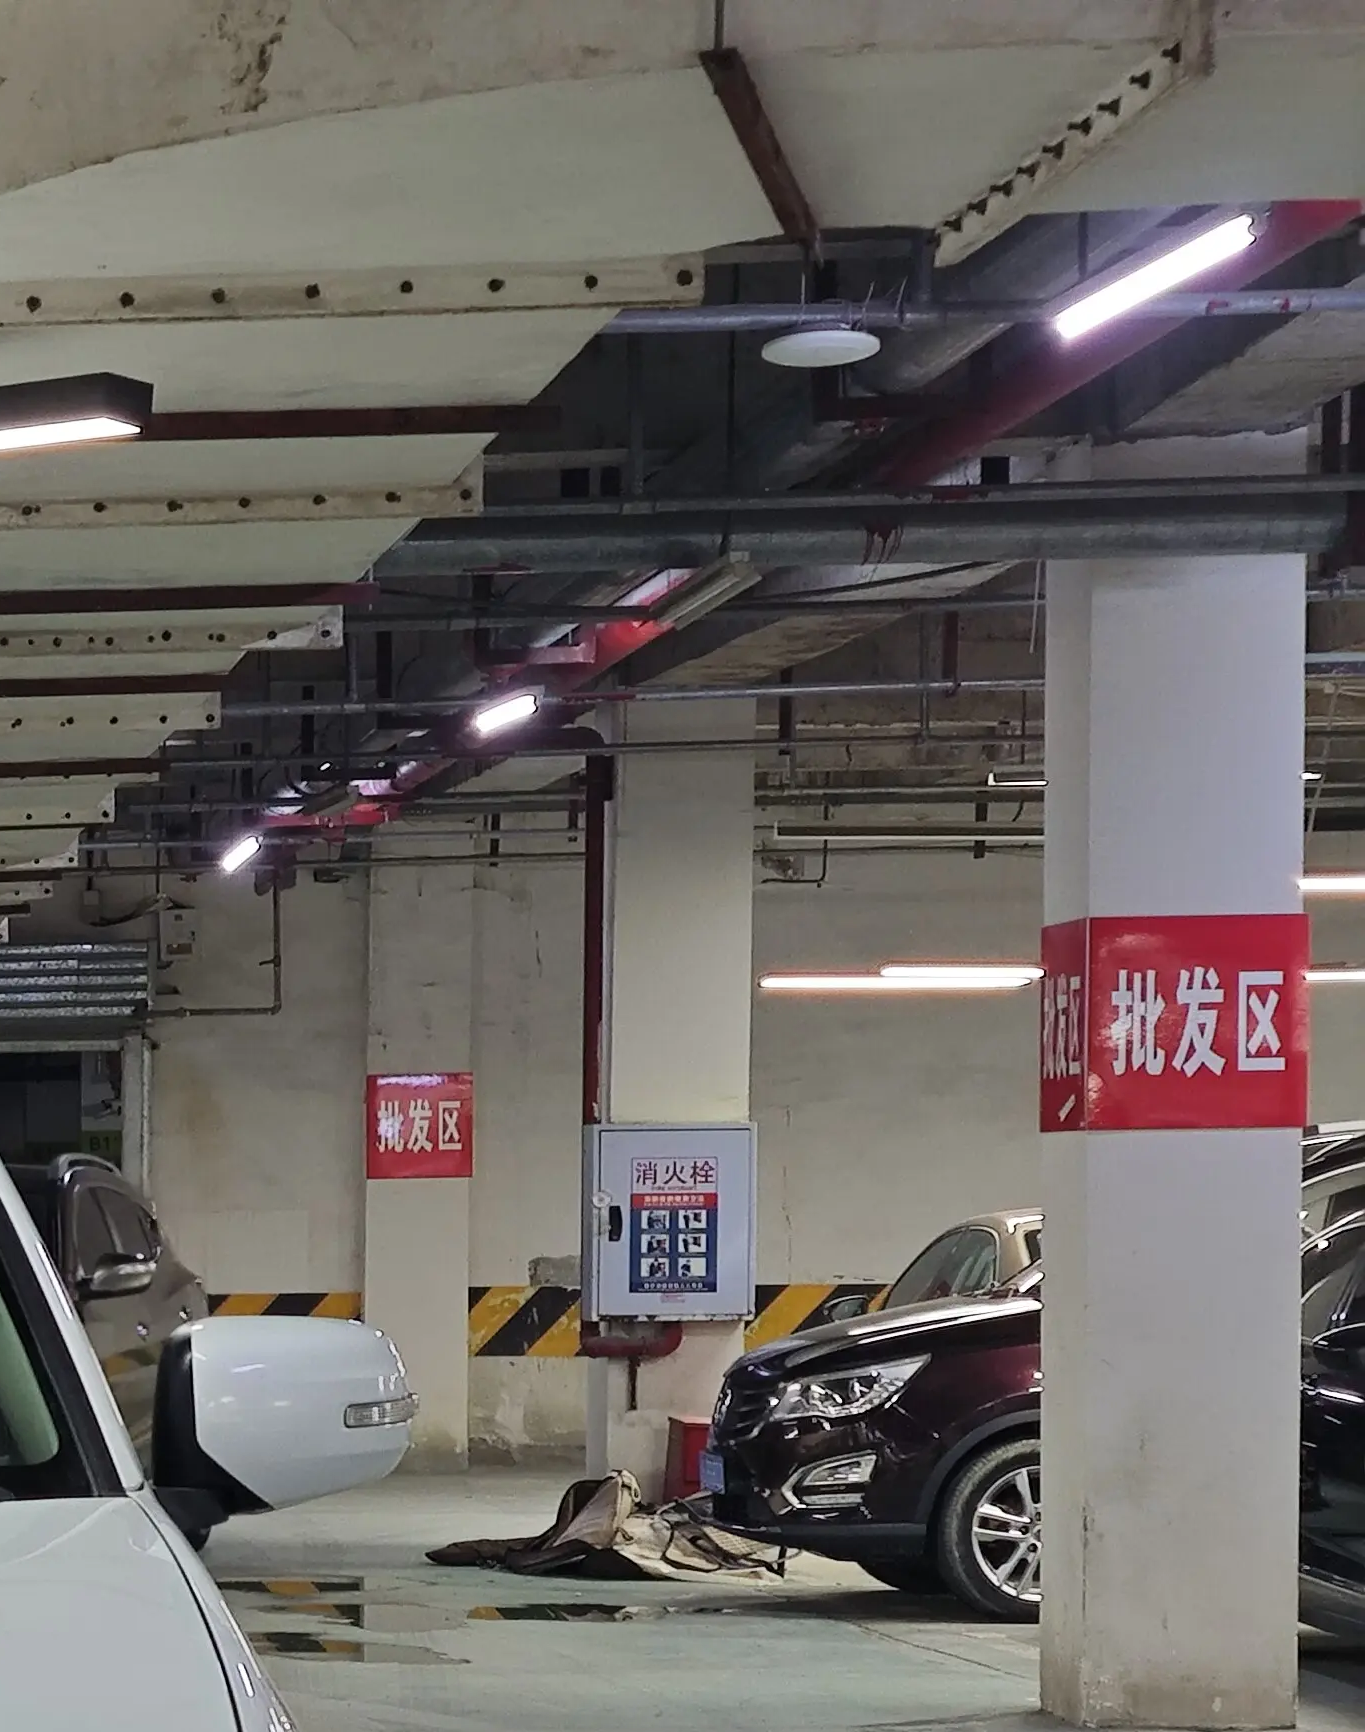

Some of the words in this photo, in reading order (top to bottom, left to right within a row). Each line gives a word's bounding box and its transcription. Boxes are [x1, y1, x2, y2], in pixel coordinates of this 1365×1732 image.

[1110, 966, 1286, 1077] 批发区
[376, 1099, 463, 1153] 批发区
[635, 1161, 716, 1185] 消火栓
